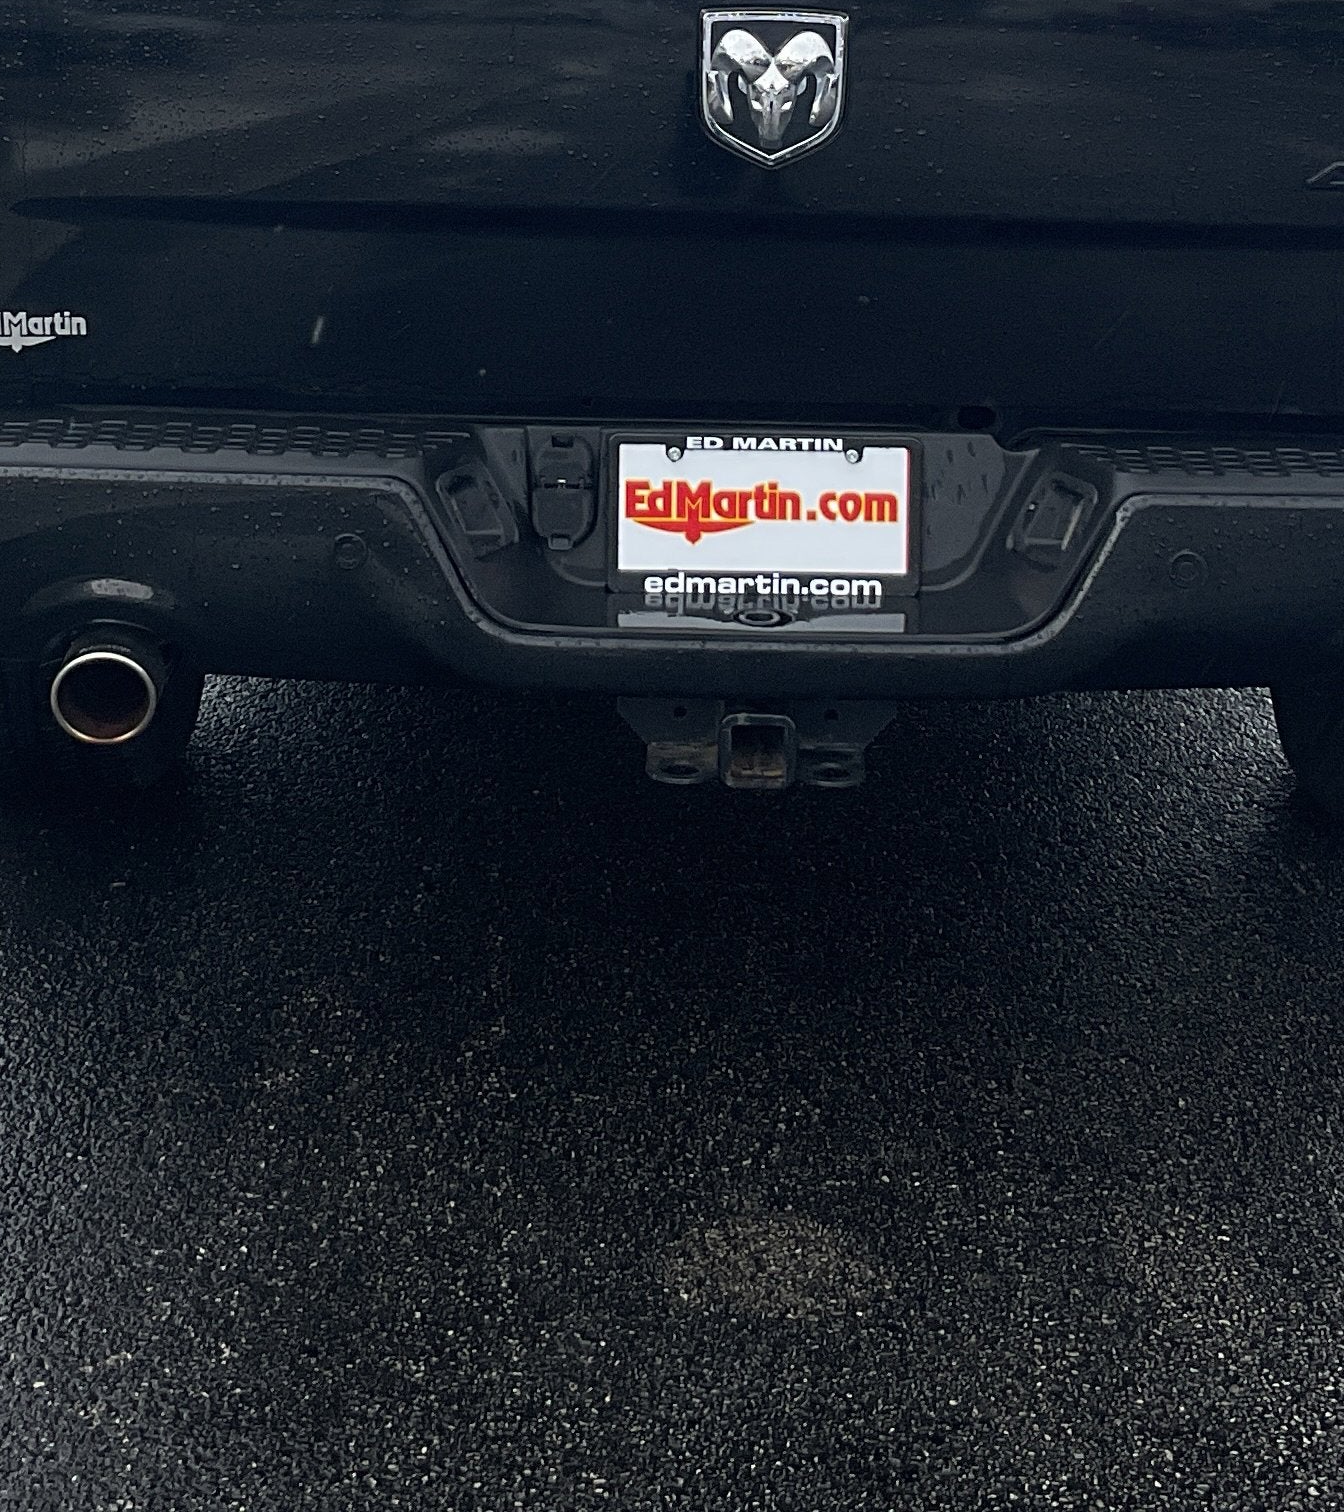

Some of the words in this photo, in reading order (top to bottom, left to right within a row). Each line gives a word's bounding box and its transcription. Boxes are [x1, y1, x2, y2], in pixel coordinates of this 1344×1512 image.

[686, 436, 724, 450] ED
[732, 437, 844, 452] MARTIN
[624, 479, 898, 528] EdMartin.com
[644, 571, 883, 596] edmartin.com
